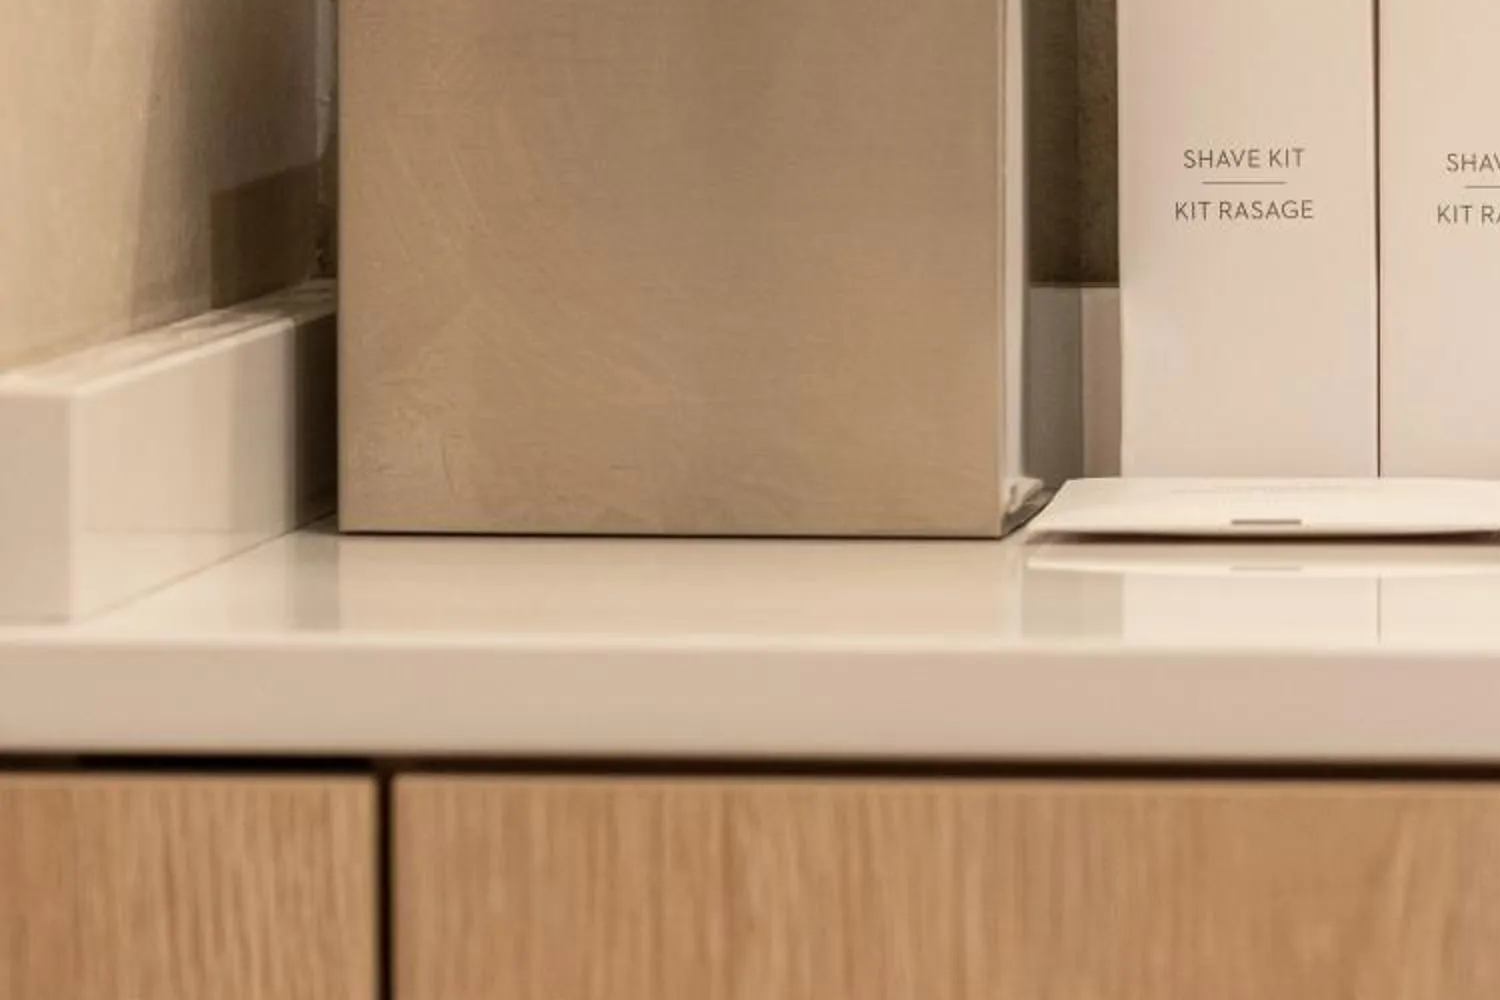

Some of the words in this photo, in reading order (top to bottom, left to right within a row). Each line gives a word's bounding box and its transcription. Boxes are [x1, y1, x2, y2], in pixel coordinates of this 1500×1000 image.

[1183, 148, 1261, 169] SHAVE
[1268, 147, 1305, 169] KIT
[1174, 200, 1212, 221] KIT
[1218, 199, 1314, 221] RASAGE
[1437, 204, 1474, 225] KIT
